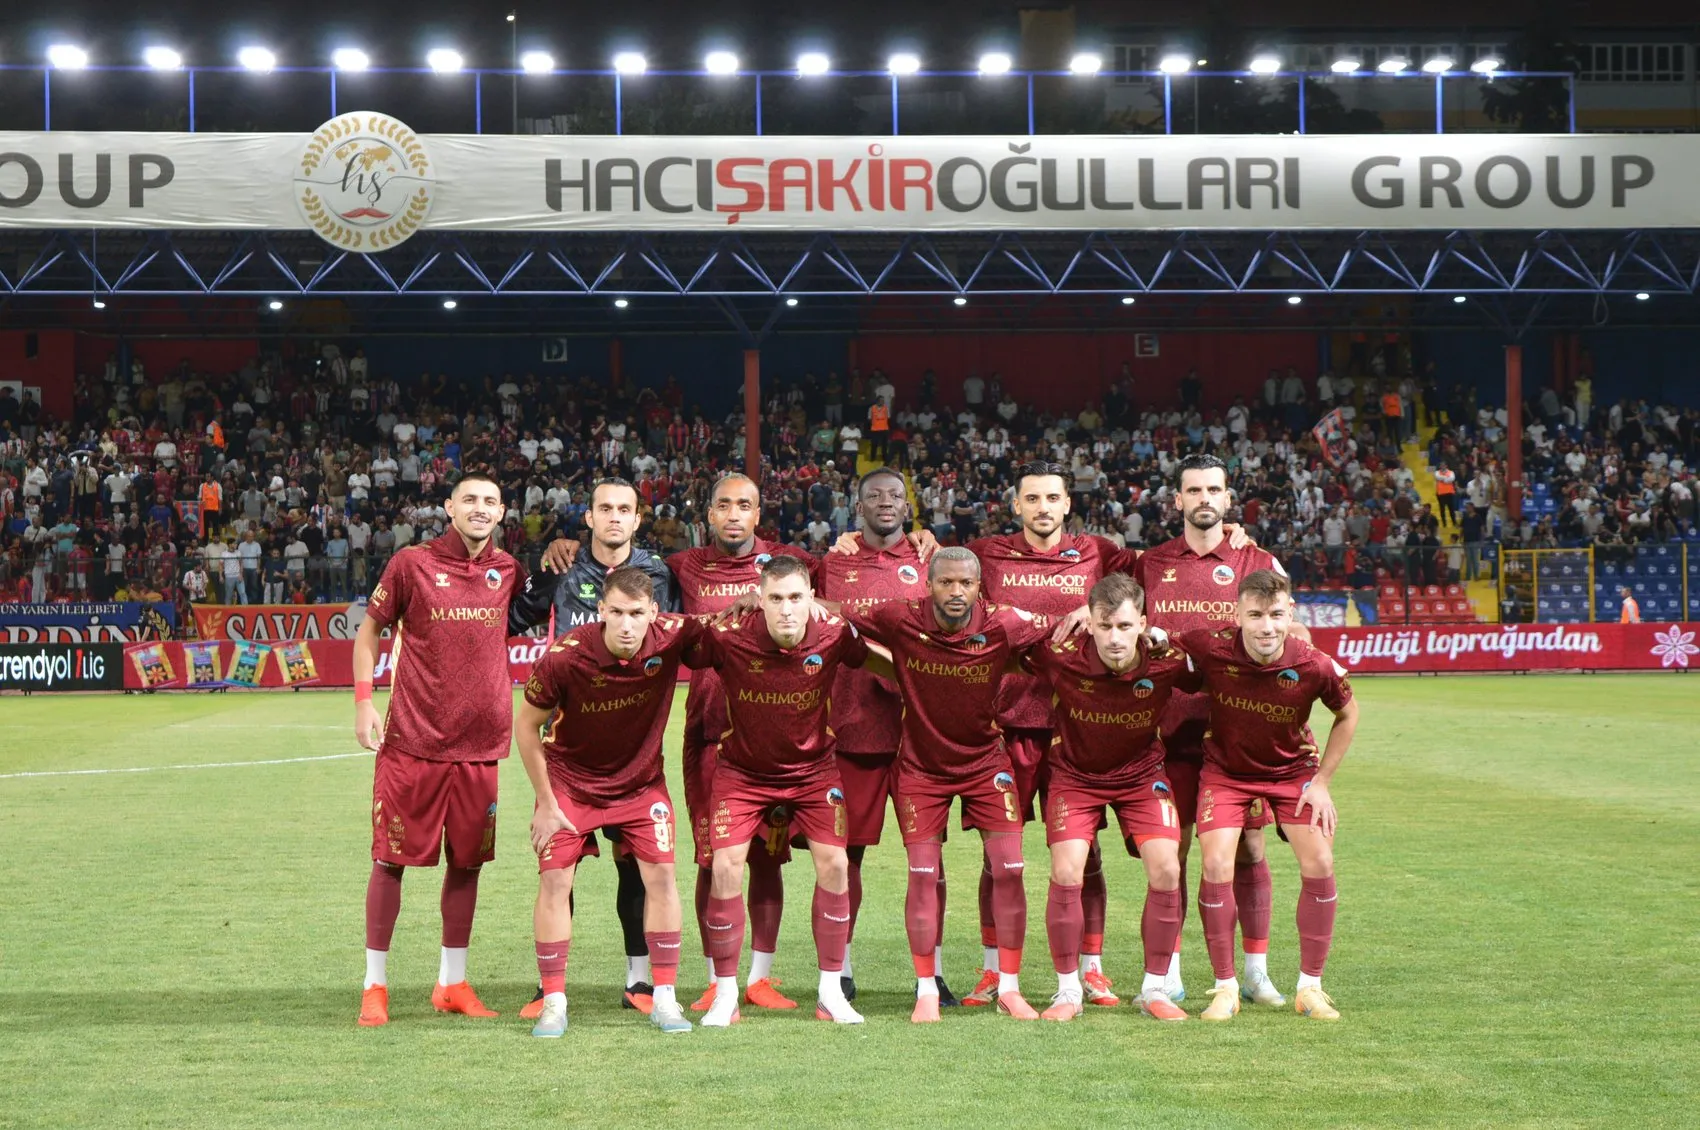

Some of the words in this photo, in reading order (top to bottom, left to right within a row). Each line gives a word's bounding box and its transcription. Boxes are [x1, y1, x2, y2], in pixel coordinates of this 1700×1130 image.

[545, 142, 1299, 225] HACIŞAKİROĞULLARI
[1351, 154, 1655, 209] GROUP
[1002, 573, 1085, 587] MAHMOOD
[22, 603, 60, 615] YARIN
[1154, 599, 1234, 614] MAHMOOD
[1337, 631, 1422, 664] iyiliği
[1427, 625, 1603, 660] toprağından
[906, 657, 990, 678] MAHMOOD
[1069, 707, 1152, 725] MAHMOOD
